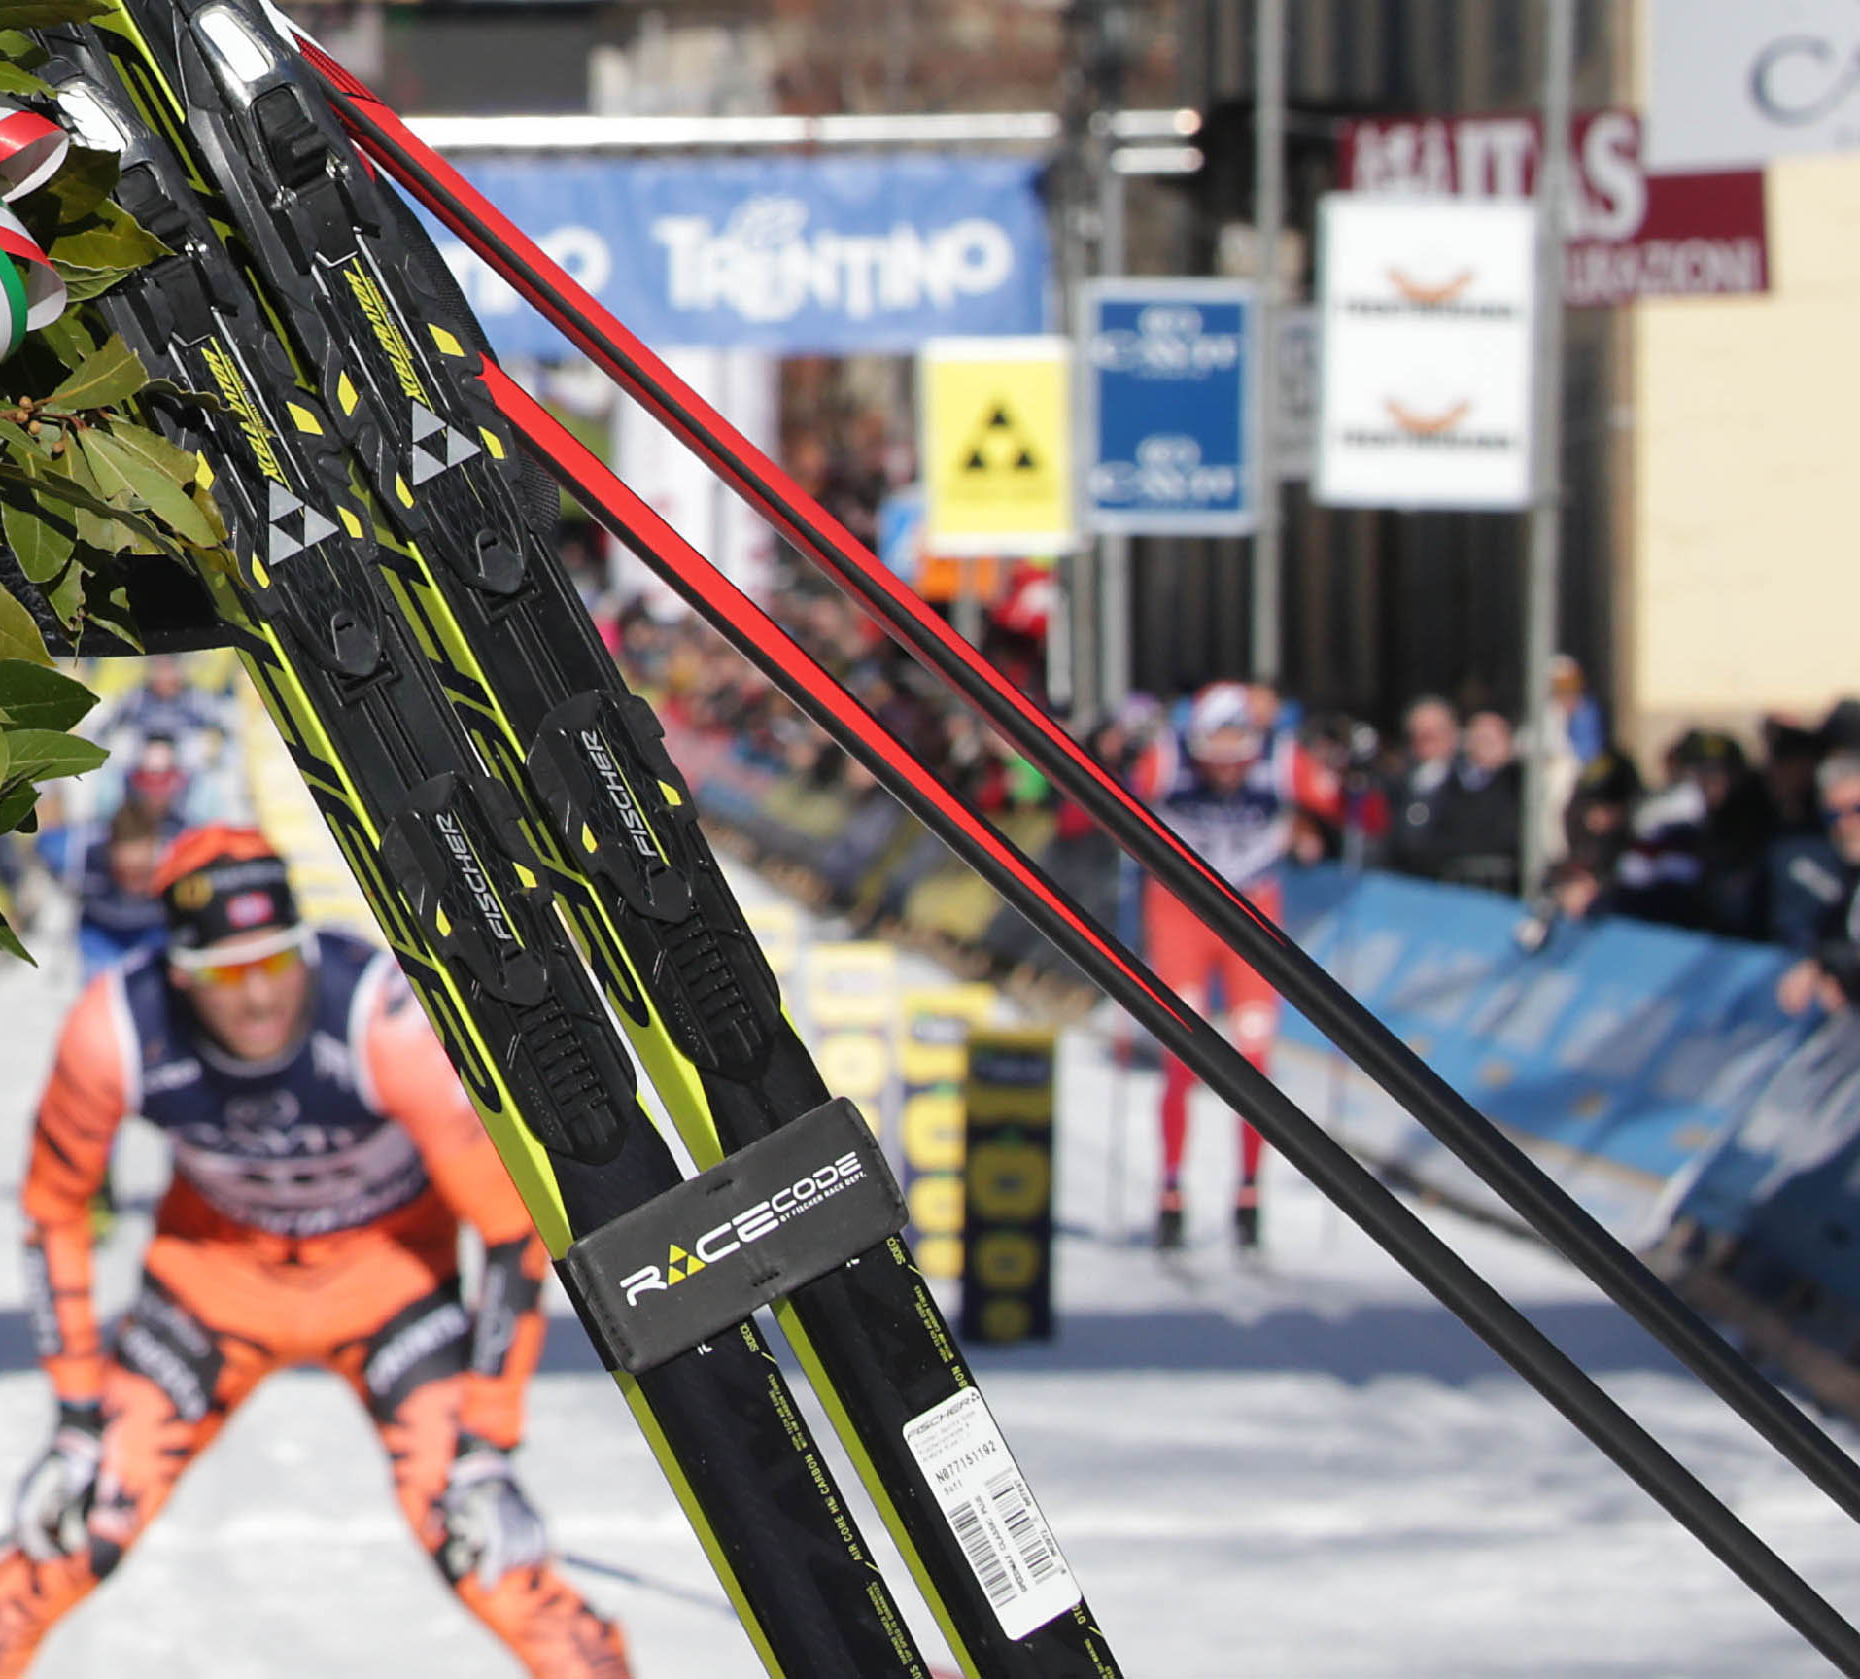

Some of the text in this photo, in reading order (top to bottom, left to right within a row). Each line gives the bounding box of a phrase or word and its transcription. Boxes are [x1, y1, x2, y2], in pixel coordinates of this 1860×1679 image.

[580, 730, 660, 858] FISCHER
[435, 813, 514, 940] FISCHER
[802, 1451, 832, 1495] CARBON
[832, 1512, 856, 1542] CORE
